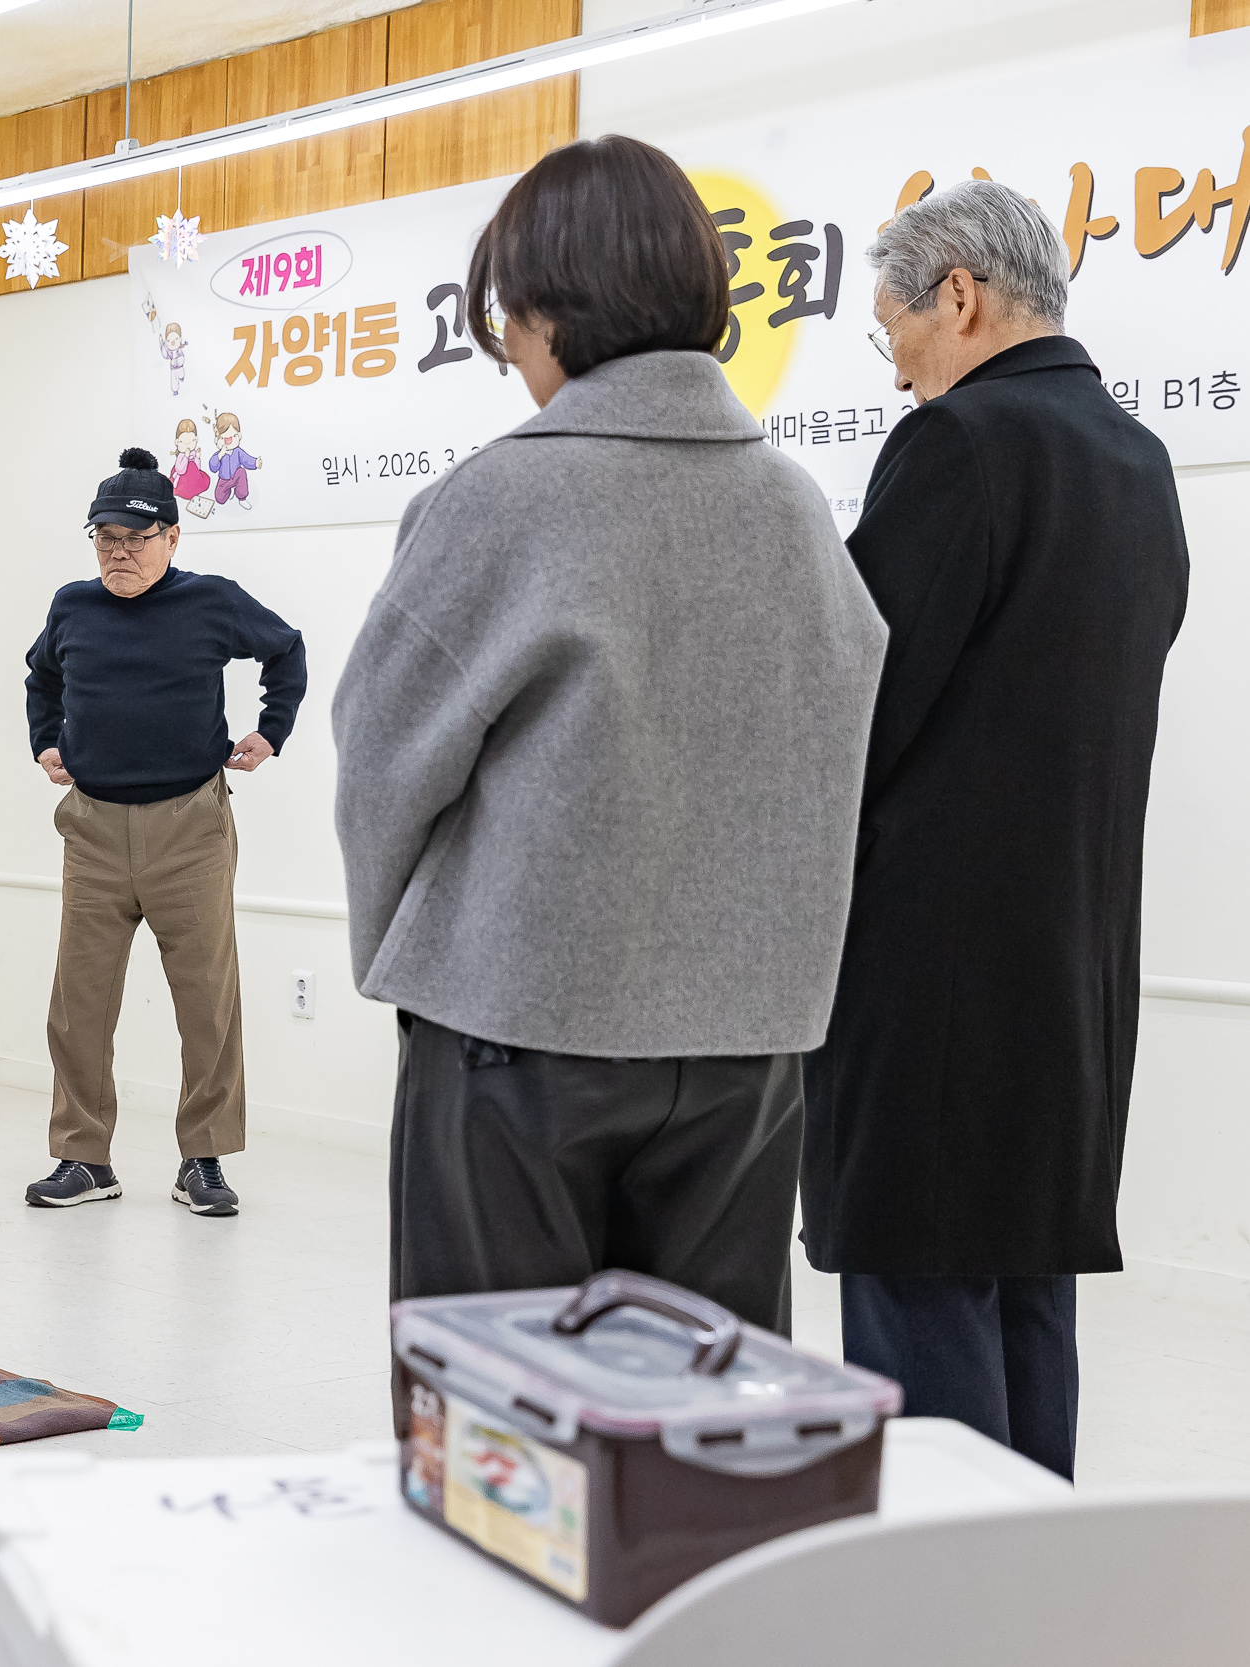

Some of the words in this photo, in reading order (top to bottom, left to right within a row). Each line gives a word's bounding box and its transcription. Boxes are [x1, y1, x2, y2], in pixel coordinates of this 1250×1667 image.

[239, 244, 323, 297] 제9회
[225, 301, 400, 388] 자양1동
[322, 455, 358, 485] 일시
[378, 451, 437, 477] 2026.
[1163, 370, 1241, 410] B1층
